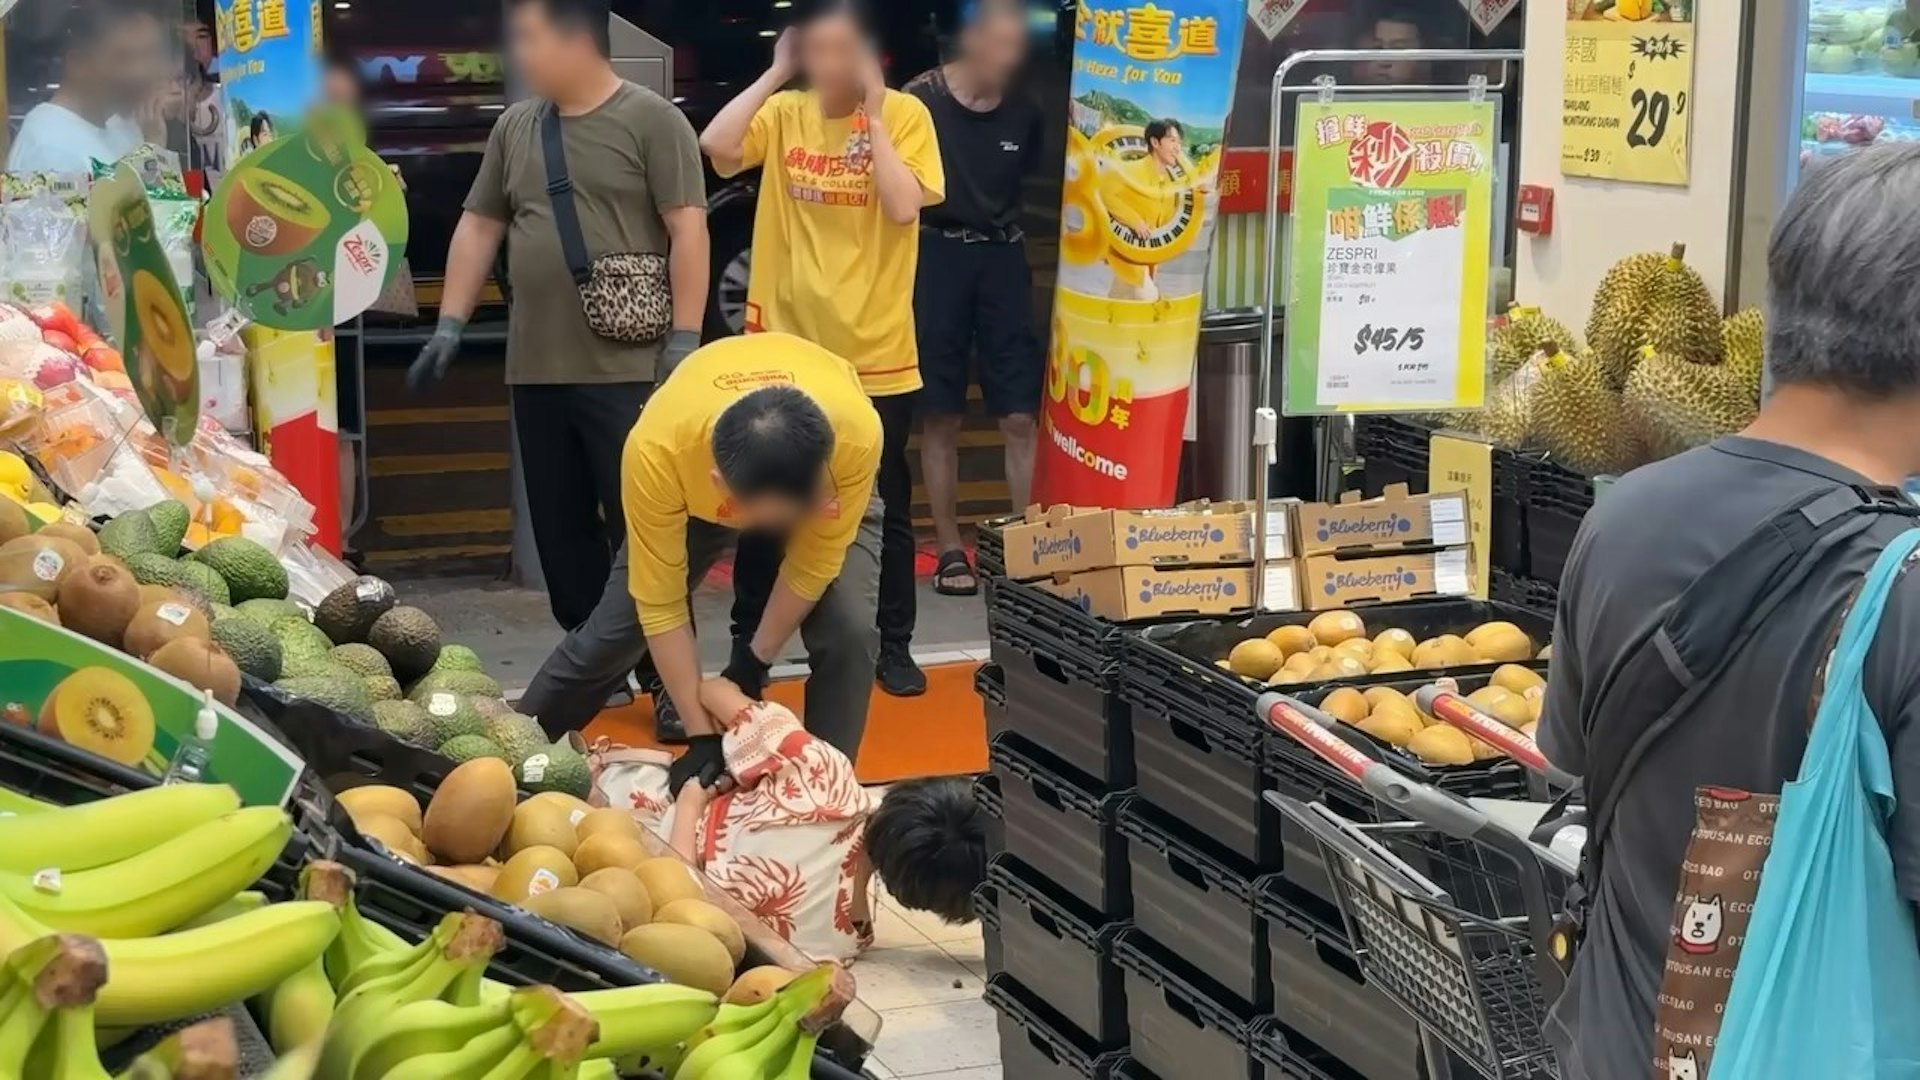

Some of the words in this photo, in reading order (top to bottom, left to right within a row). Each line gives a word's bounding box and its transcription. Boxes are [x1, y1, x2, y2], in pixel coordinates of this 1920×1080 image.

[1566, 36, 1597, 63] 泰國
[1121, 63, 1148, 84] for
[1154, 67, 1182, 85] You
[821, 180, 870, 189] COLLECT
[343, 234, 376, 277] Zespri
[1327, 247, 1378, 260] ZESPRI
[1053, 427, 1128, 481] wellcome
[1139, 525, 1210, 548] Blueberry
[1329, 515, 1397, 537] Blueberry
[1153, 578, 1222, 601] Blueberry
[1336, 571, 1402, 590] Blueberry
